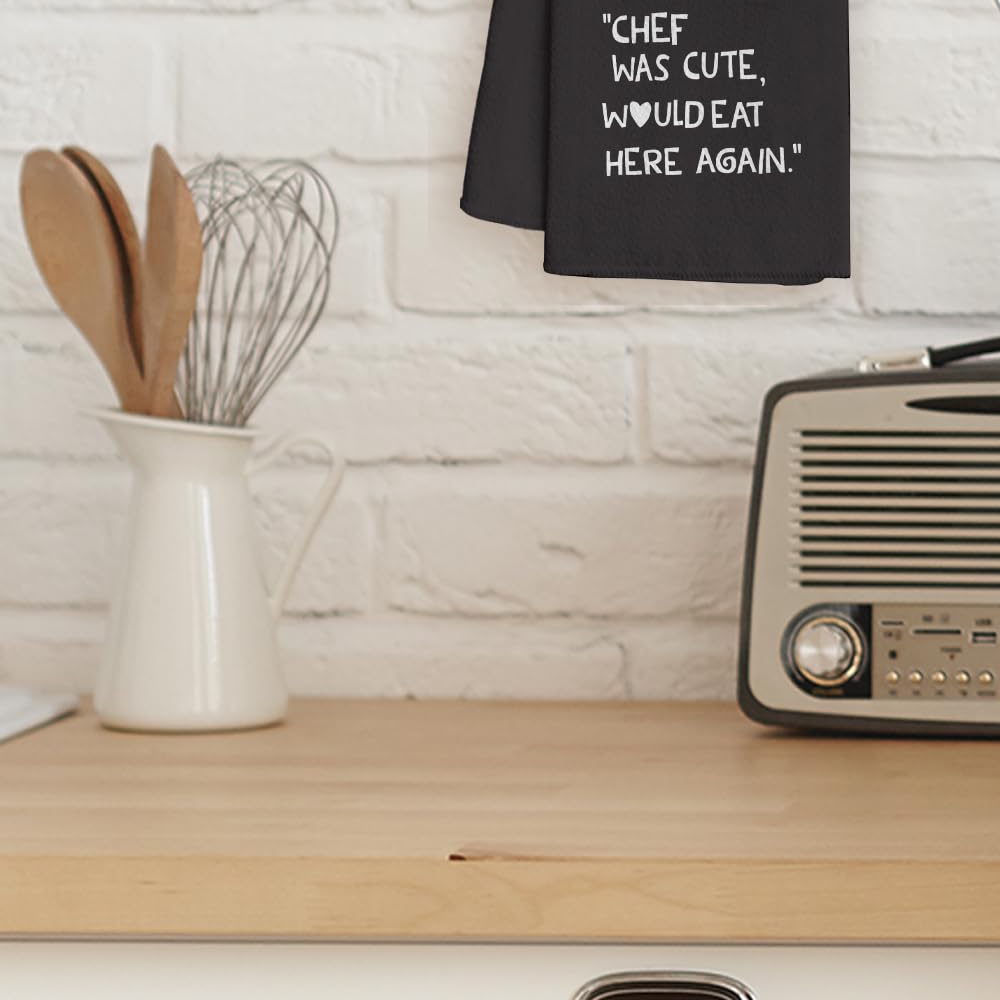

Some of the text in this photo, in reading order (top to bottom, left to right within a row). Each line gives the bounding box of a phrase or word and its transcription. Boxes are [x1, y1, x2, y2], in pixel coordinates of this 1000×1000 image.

[602, 11, 689, 46] "CHEF
[611, 48, 767, 87] WAS CUTE,
[711, 99, 764, 129] EAT
[605, 143, 802, 177] HERE AGAIN."
